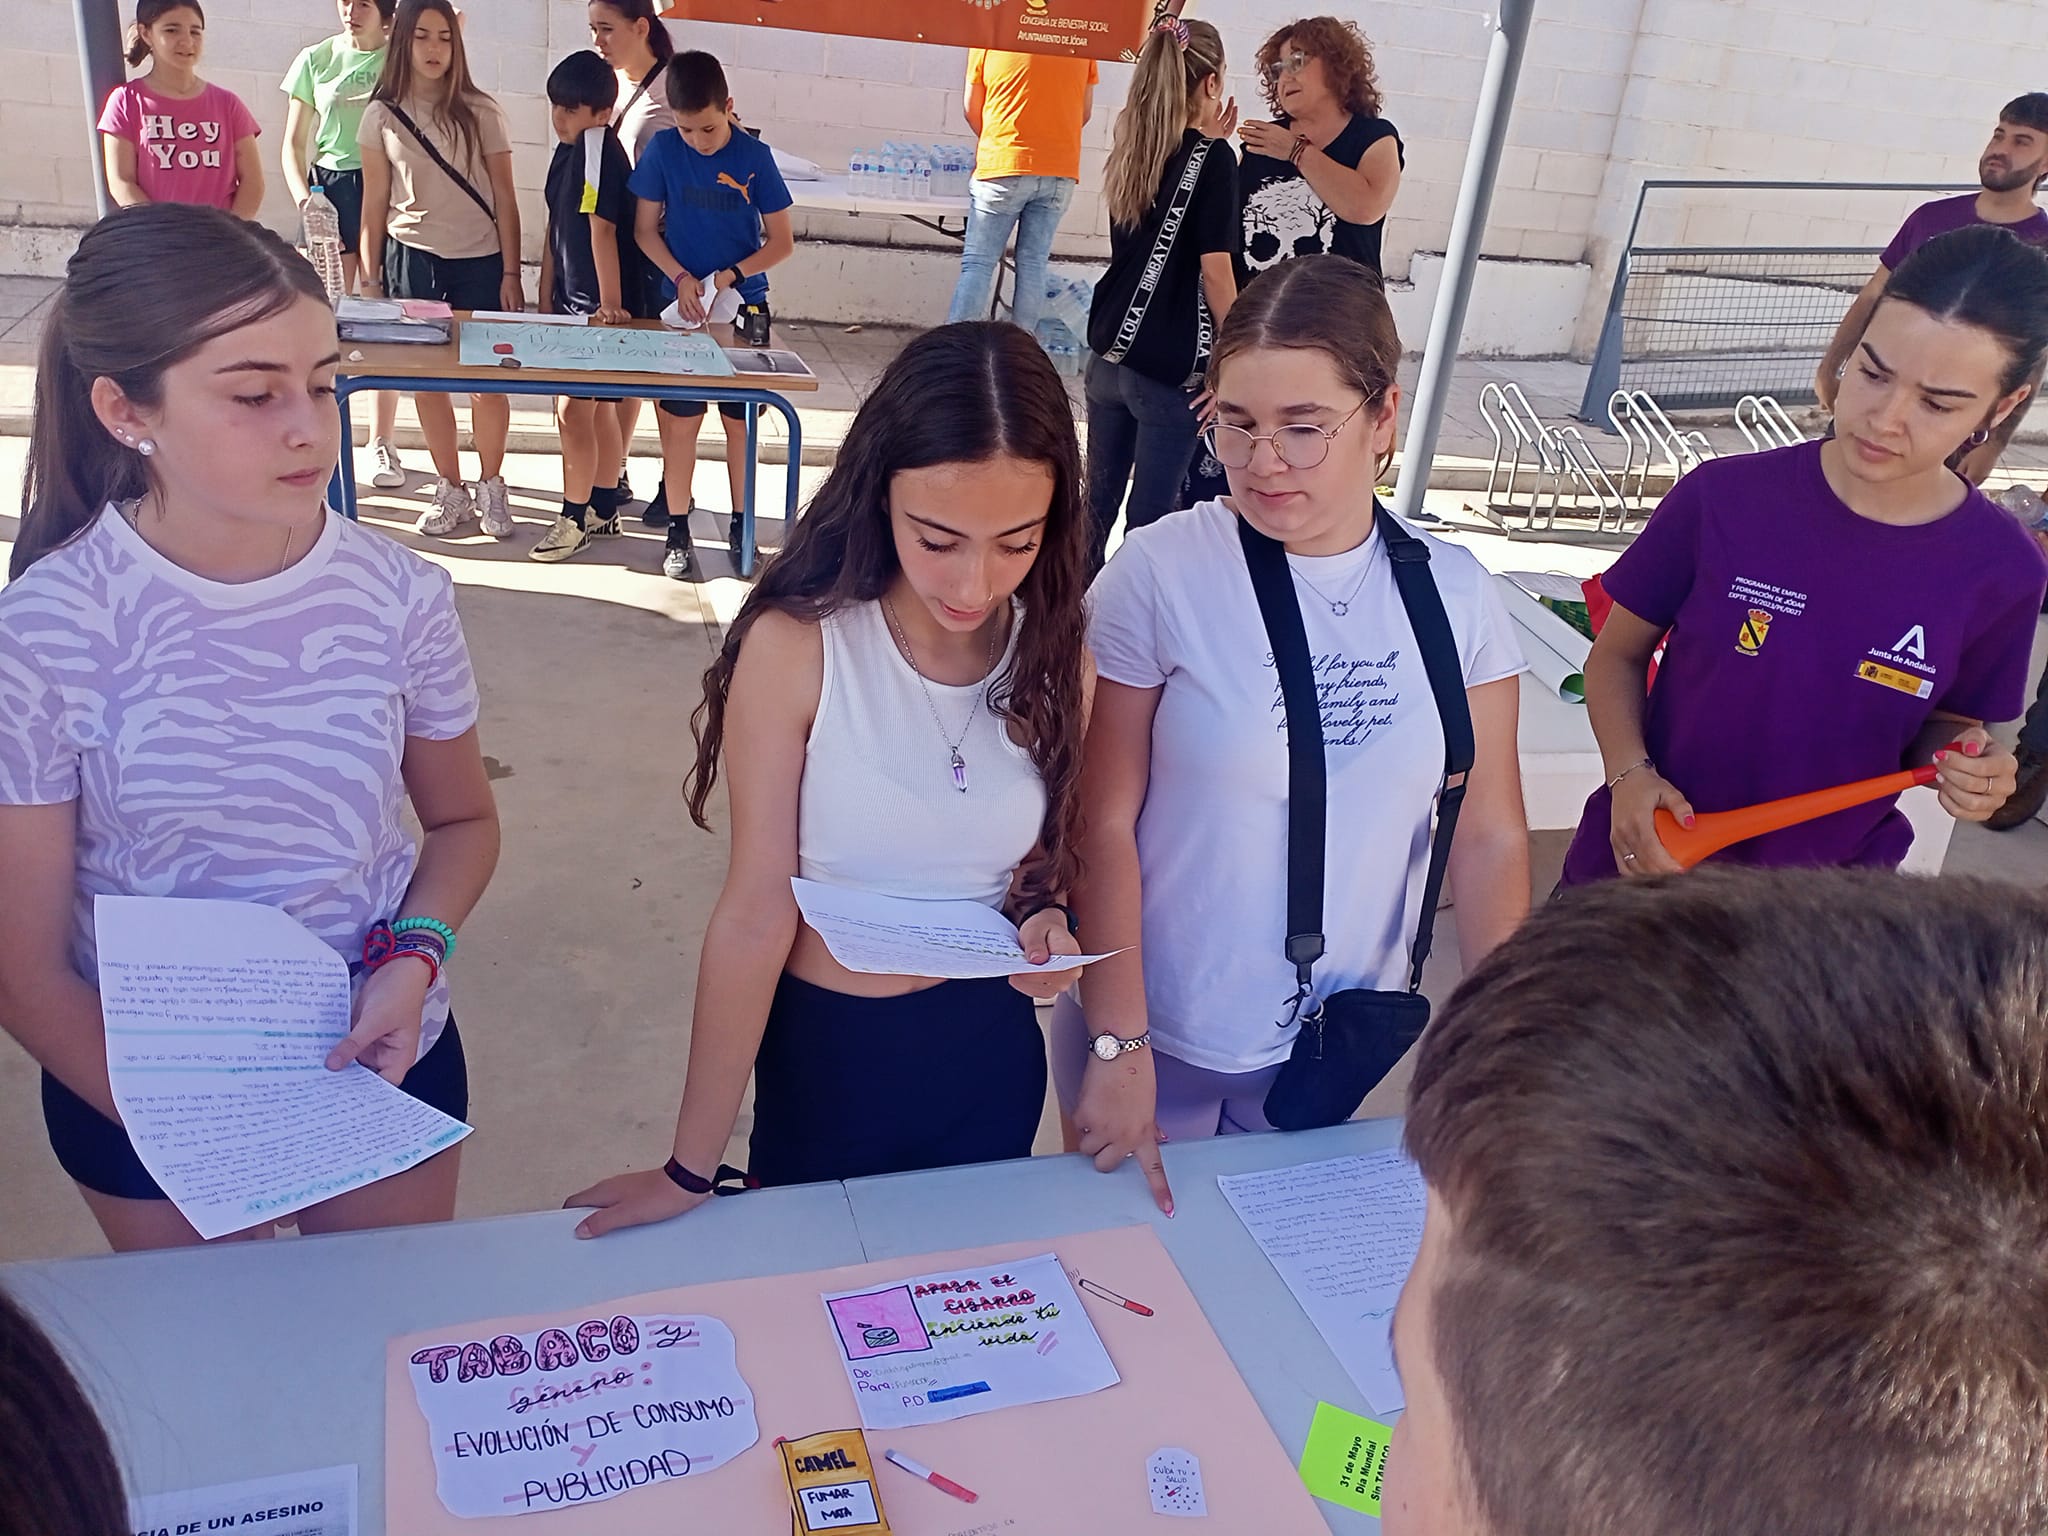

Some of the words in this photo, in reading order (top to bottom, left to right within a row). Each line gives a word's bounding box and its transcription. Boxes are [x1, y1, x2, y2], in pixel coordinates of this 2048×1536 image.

[1017, 30, 1060, 44] AYUNTAMIENTO
[1061, 35, 1069, 45] DE
[1058, 18, 1088, 30] BIENESTAR
[1088, 21, 1109, 32] SOCIAL
[144, 114, 220, 143] Hey
[150, 143, 221, 169] You
[1180, 152, 1204, 191] BIMBA
[1141, 253, 1166, 292] BIMBA
[1161, 205, 1184, 241] LOLA
[1122, 306, 1145, 341] LOLA
[1199, 323, 1212, 358] LOLA
[1735, 576, 1771, 591] PROGRAMA
[1771, 585, 1781, 593] DE
[1781, 588, 1808, 600] EMPLEO
[1736, 585, 1775, 601] FORMACIÓN
[1774, 595, 1783, 603] DE
[1324, 652, 1349, 677] for
[1351, 659, 1375, 681] you
[1867, 647, 1892, 660] Junta
[1892, 654, 1904, 664] de
[1903, 658, 1937, 675] Andalucía
[1368, 692, 1400, 707] and
[411, 1315, 641, 1384] TABACO
[978, 1330, 1039, 1348] vida
[454, 1417, 570, 1458] EVOLUCIÓN
[586, 1411, 622, 1439] DE
[632, 1396, 735, 1430] CONSUMO
[794, 1448, 857, 1474] CAMEL
[1347, 1435, 1362, 1461] Mayo
[1360, 1440, 1377, 1477] Mundial
[523, 1448, 692, 1507] PUBLICIDAD
[1345, 1461, 1355, 1474] de
[1340, 1475, 1351, 1488] 31
[1370, 1485, 1382, 1501] Sin
[807, 1487, 855, 1505] FUMAR
[176, 1521, 202, 1536] DE
[207, 1515, 235, 1530] UN
[240, 1501, 324, 1525] ASESINO
[820, 1506, 853, 1521] MATA
